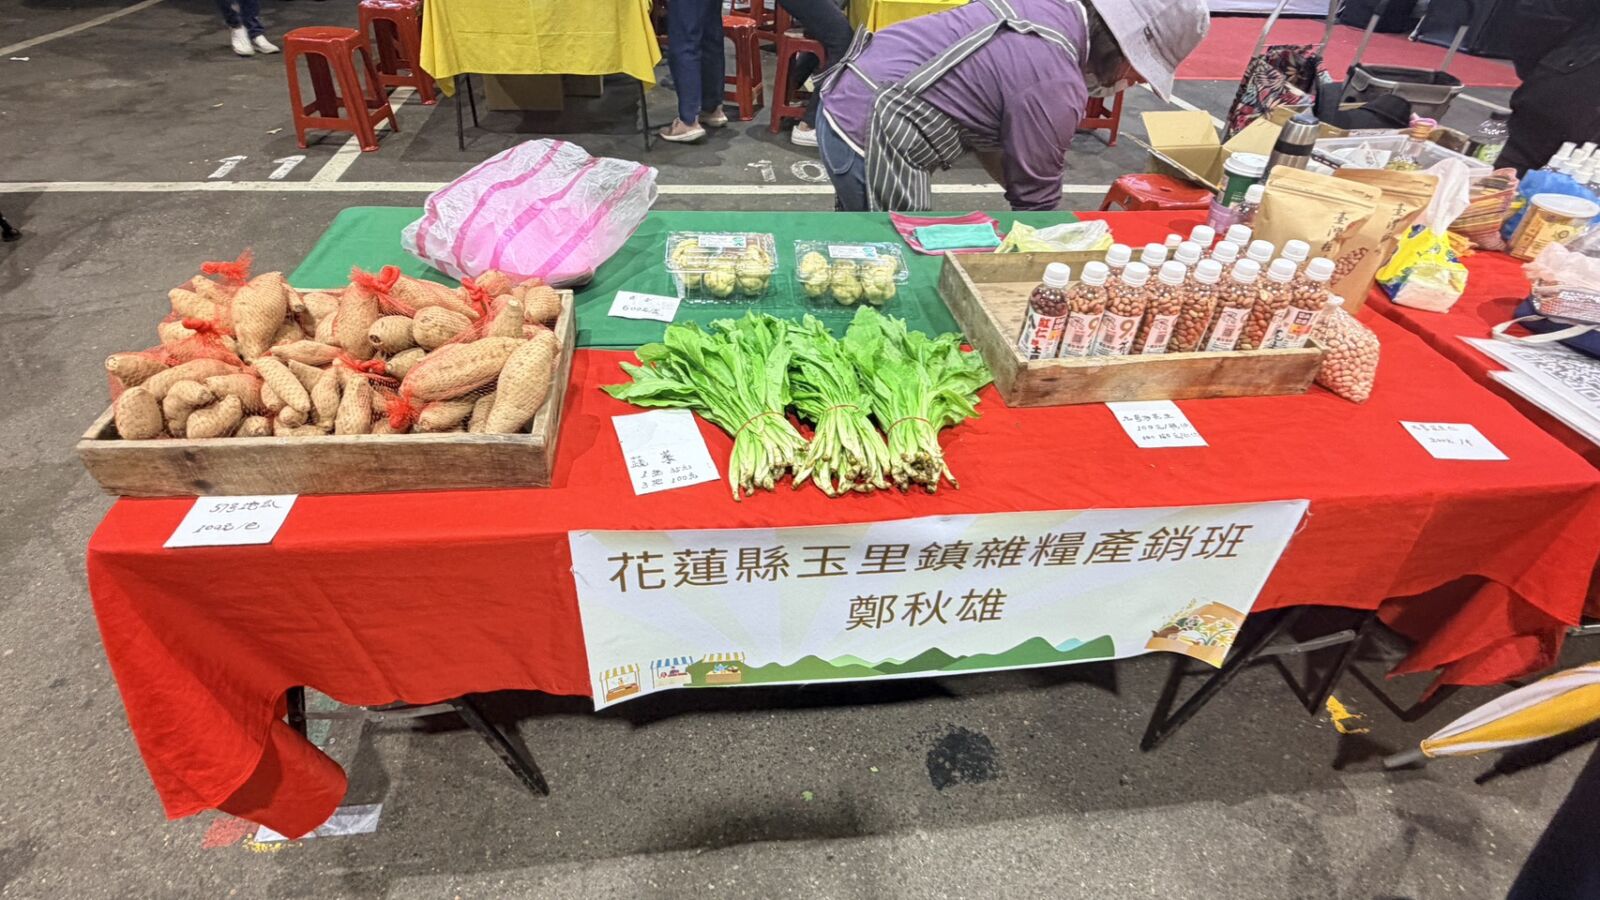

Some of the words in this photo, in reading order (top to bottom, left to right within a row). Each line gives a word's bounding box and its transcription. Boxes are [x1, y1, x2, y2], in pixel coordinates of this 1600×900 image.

[607, 522, 1253, 593] 花蓮縣玉里鎮雜糧產銷班
[846, 587, 1008, 631] 鄭秋雄
